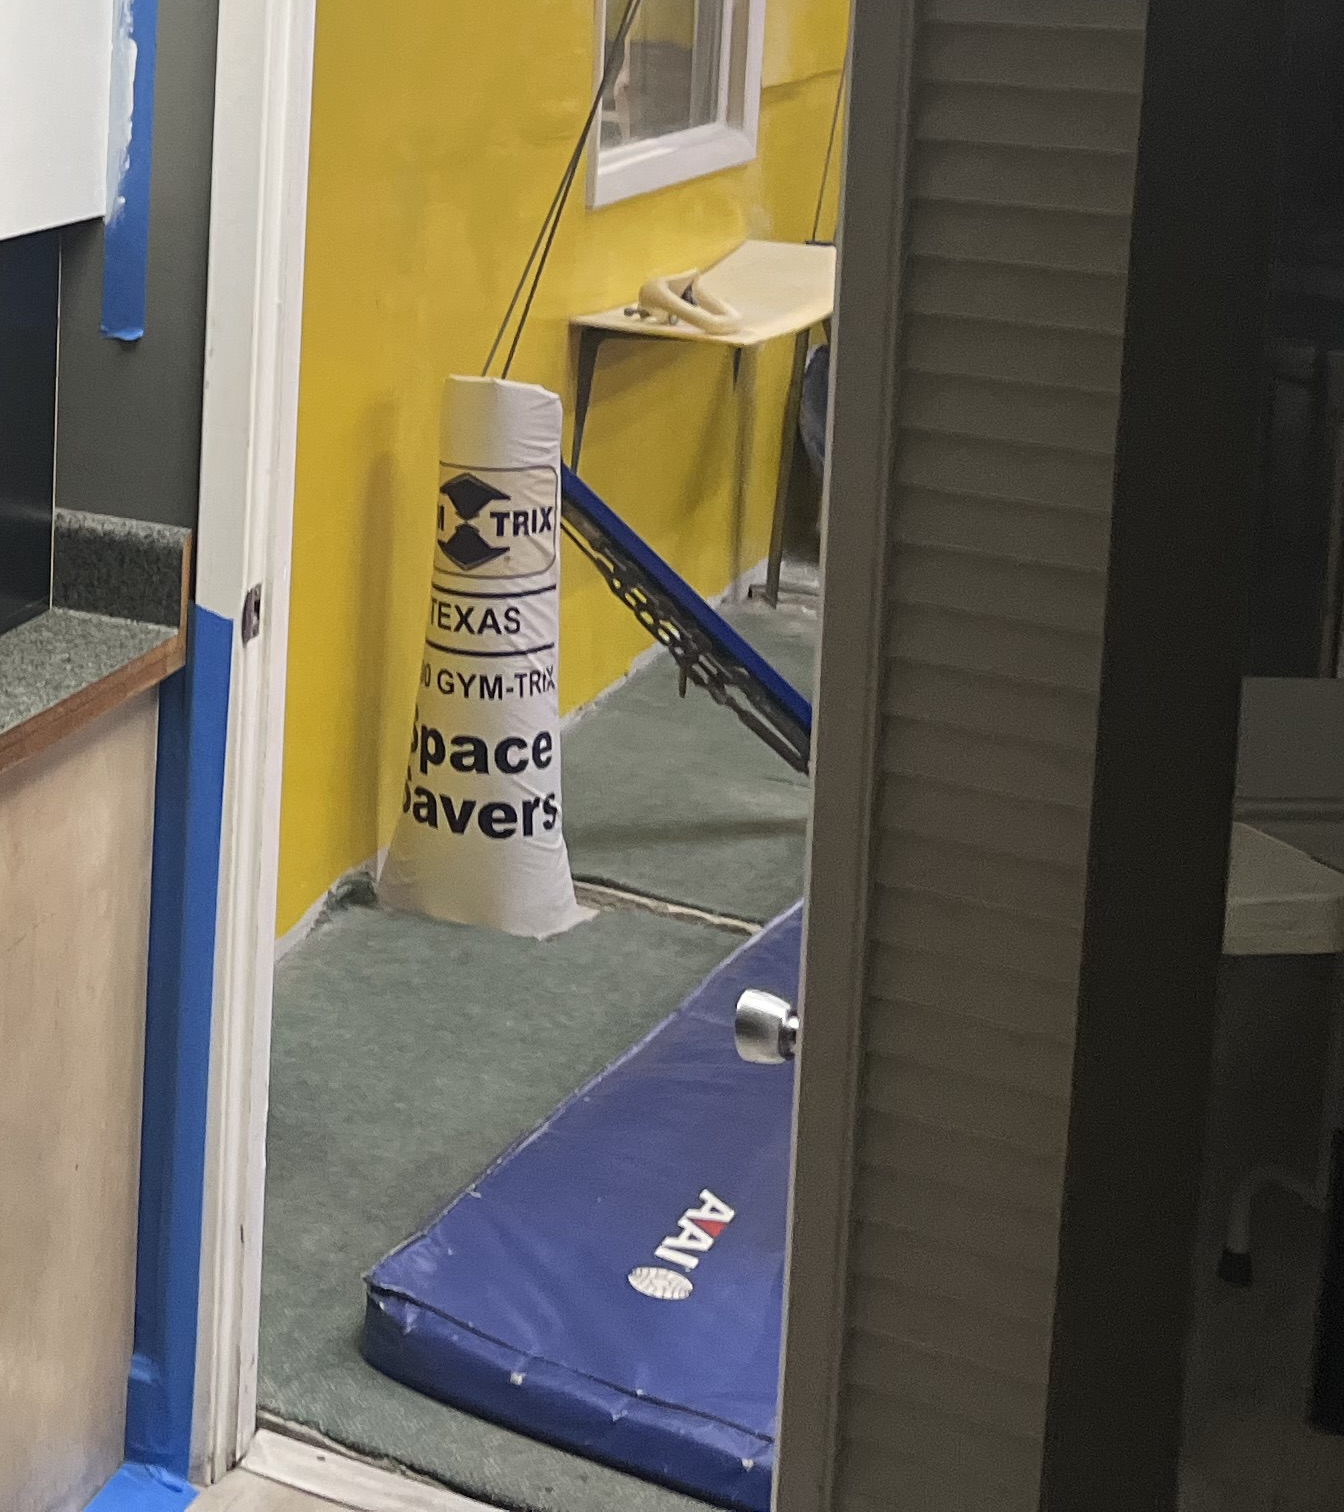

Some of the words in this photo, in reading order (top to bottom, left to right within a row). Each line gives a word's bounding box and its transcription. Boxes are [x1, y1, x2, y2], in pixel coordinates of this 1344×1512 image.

[490, 506, 553, 538] TRIX
[429, 598, 522, 635] TEXAS
[436, 665, 557, 701] GYM-TRIX
[653, 1188, 735, 1270] AAI
